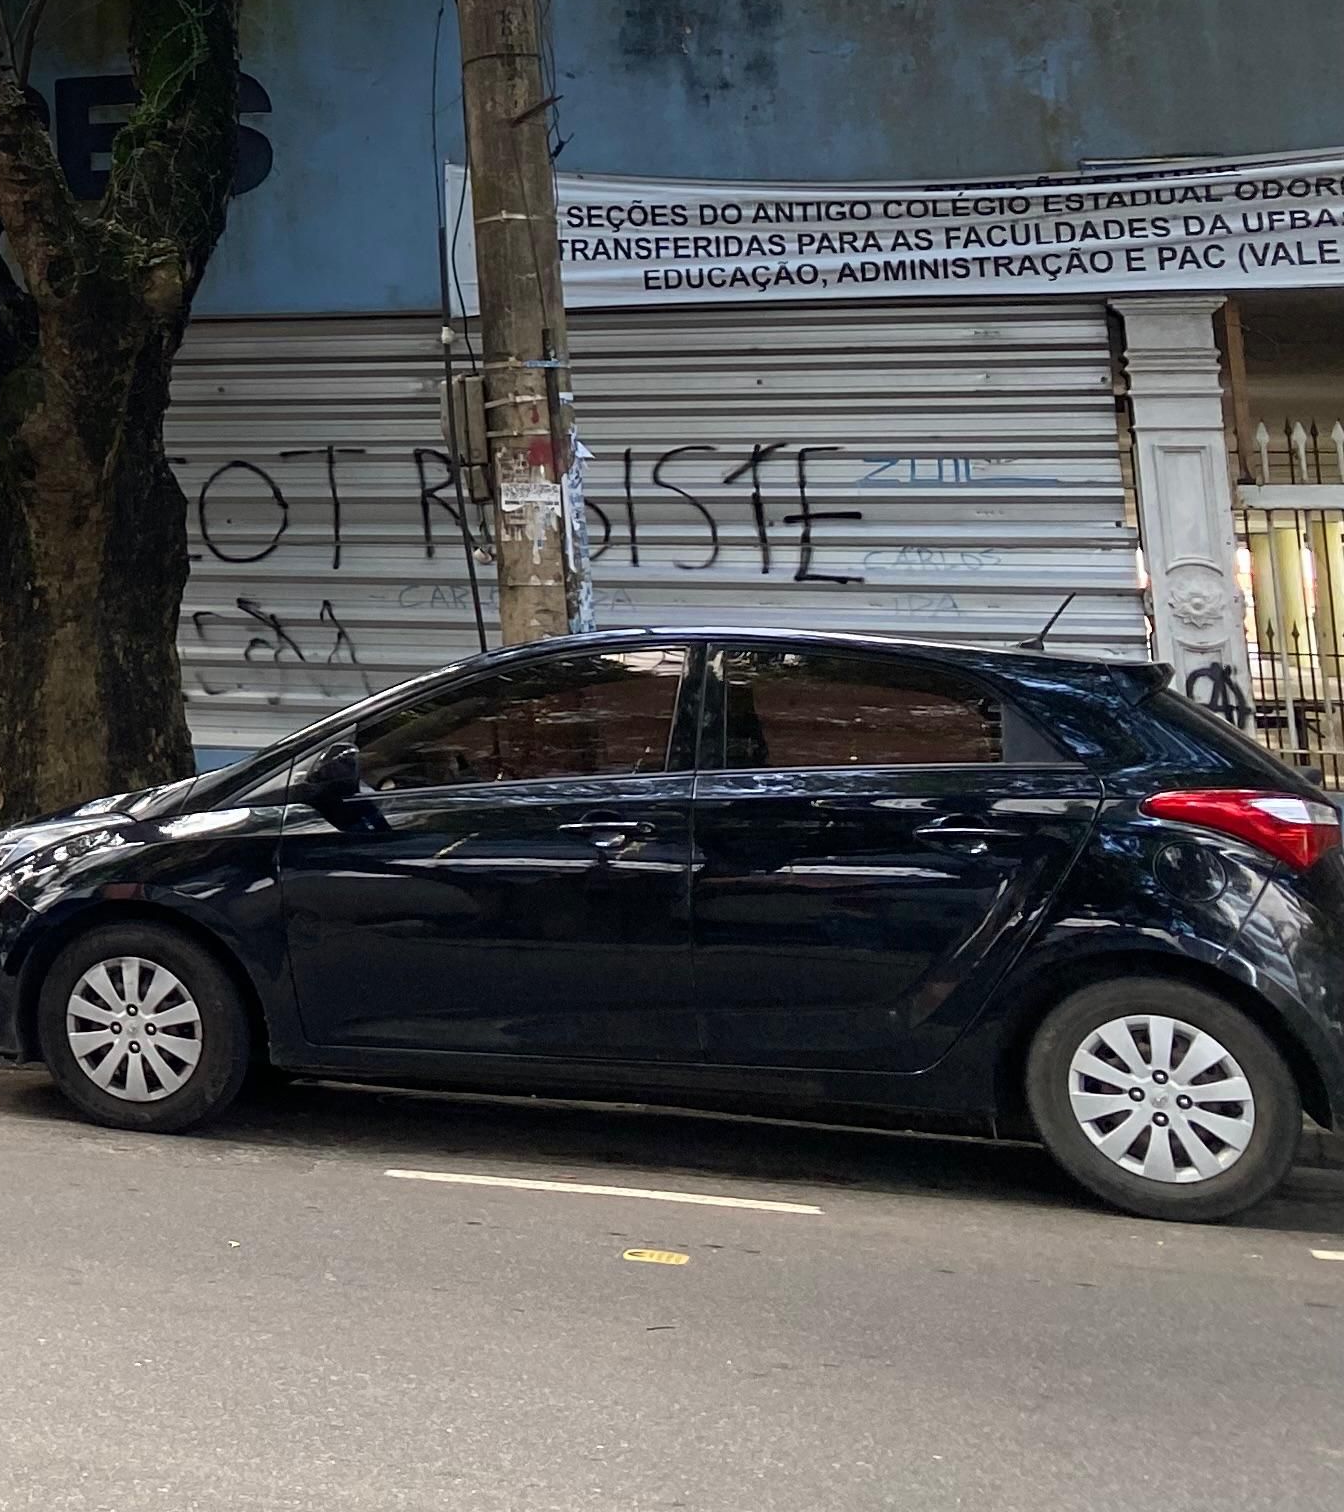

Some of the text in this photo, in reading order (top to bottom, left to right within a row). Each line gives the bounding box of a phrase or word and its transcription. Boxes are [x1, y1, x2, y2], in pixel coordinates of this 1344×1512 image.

[566, 199, 689, 233] SEÇÕES
[698, 203, 743, 226] DO
[751, 200, 872, 224] ANTIGO
[882, 191, 1032, 220] COLÉGIO
[1042, 184, 1224, 213] ESTADUAL
[797, 230, 883, 256] PARA
[890, 228, 934, 252] AS
[944, 216, 1171, 250] FACULDADES
[1183, 214, 1233, 237] DA
[643, 238, 1341, 293] EDUCAÇÃO, ADMINISTRAÇÃO E PAC (VALE
